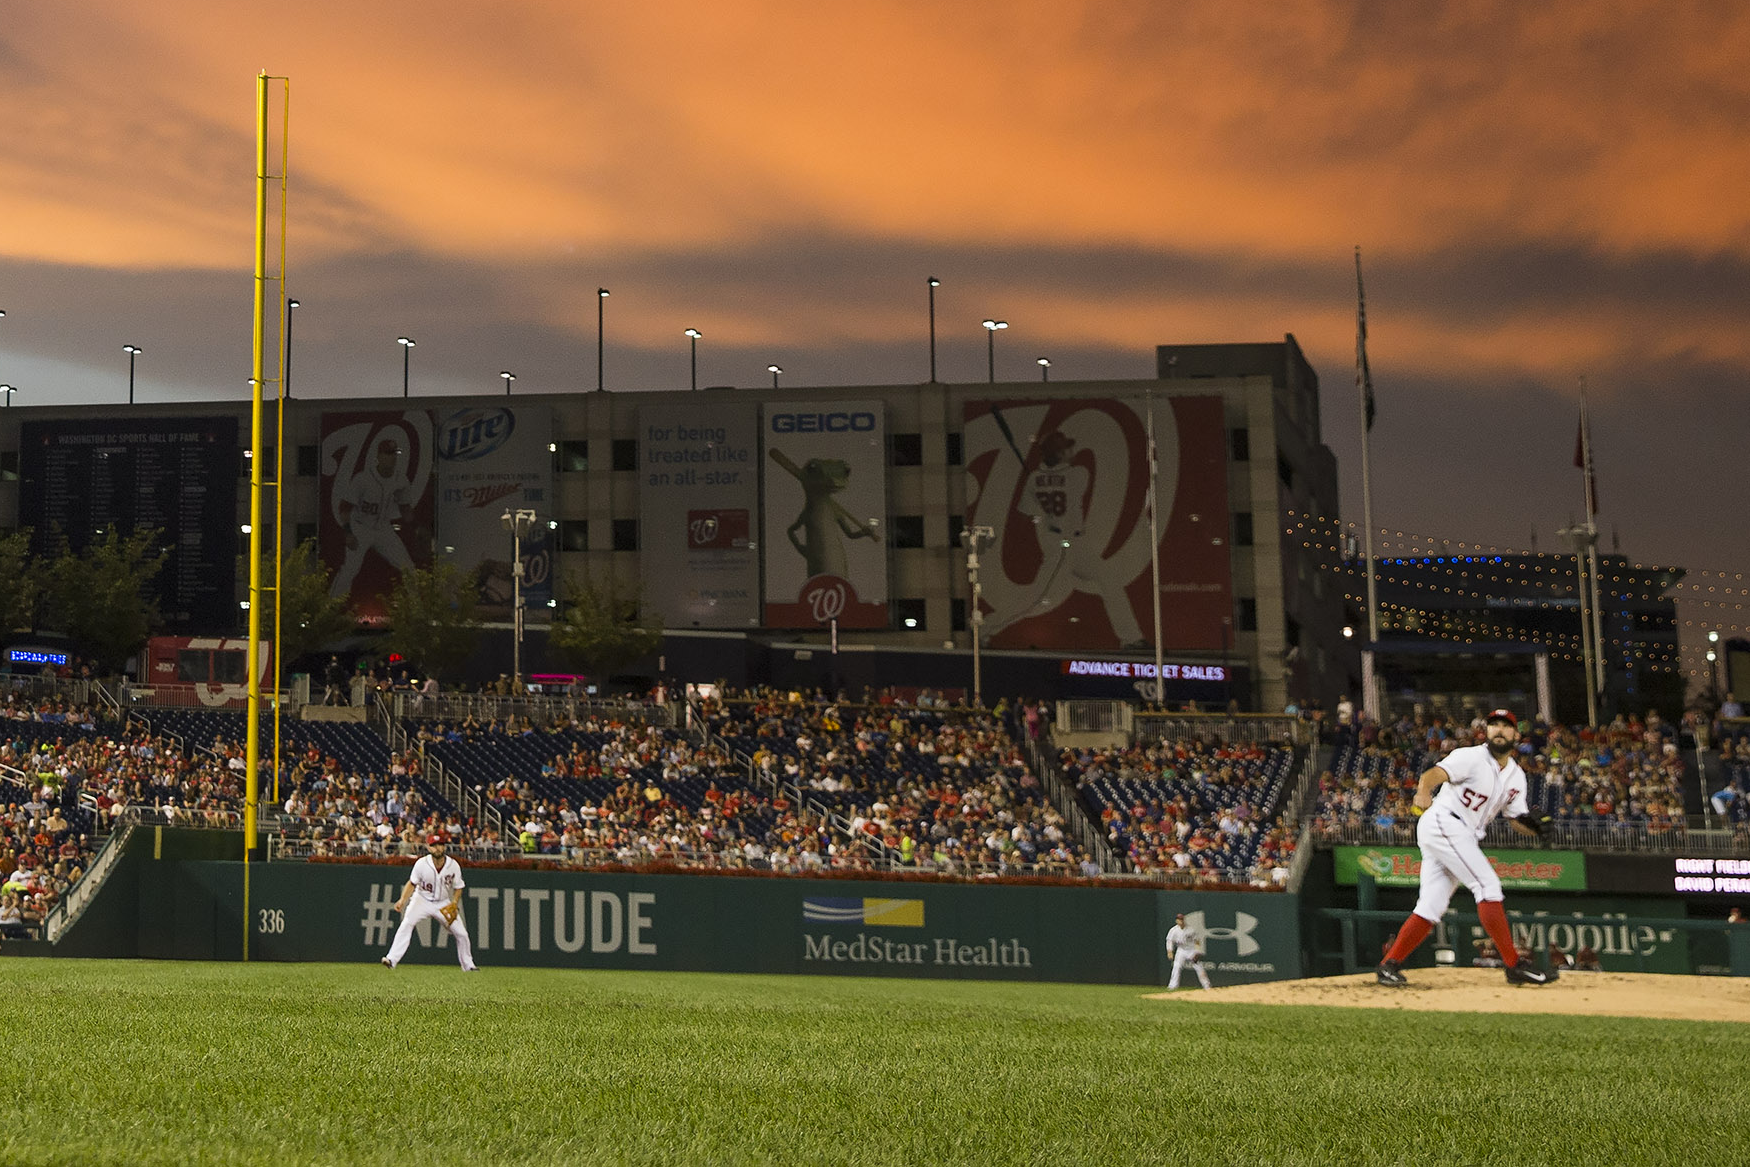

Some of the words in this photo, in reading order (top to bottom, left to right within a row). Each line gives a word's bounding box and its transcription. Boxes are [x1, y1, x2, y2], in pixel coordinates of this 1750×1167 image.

[772, 412, 875, 433] GEICO
[58, 435, 104, 445] WASHINGTON
[119, 434, 147, 444] SPORTS
[149, 434, 167, 443] HALL
[169, 434, 179, 443] OF
[180, 433, 200, 443] FAME
[446, 413, 507, 459] Lite
[648, 425, 672, 441] for
[678, 425, 726, 443] being
[648, 448, 712, 464] treated
[716, 447, 748, 463] like
[648, 472, 670, 486] an
[674, 469, 743, 486] all-star.
[463, 483, 521, 508] Miller
[1069, 661, 1131, 677] ADVANCE
[1182, 666, 1225, 681] SALES
[1462, 787, 1489, 812] 57
[1675, 858, 1714, 874] RIGHT
[1674, 876, 1714, 892] DAVID
[258, 908, 285, 933] 336
[804, 933, 929, 963] MedStar
[933, 937, 1033, 968] Health
[1217, 962, 1275, 973] ARMOUR
